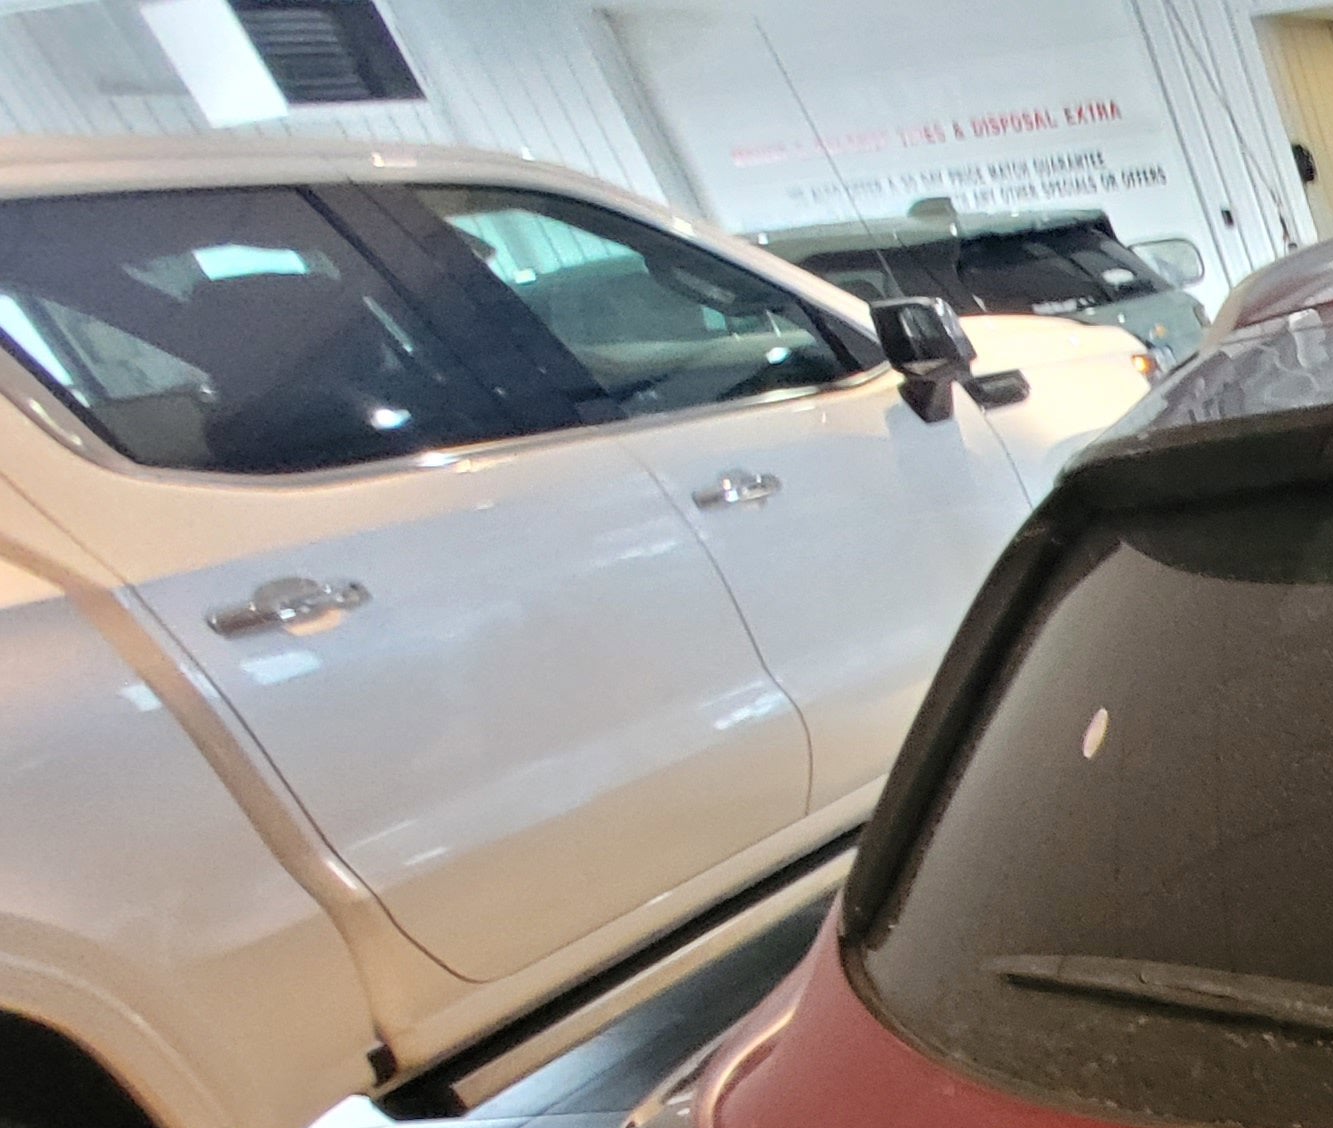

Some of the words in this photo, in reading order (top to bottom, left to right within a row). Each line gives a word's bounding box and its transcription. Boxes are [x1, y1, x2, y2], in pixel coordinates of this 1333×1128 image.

[970, 107, 1058, 139] DISPOSAL
[1063, 98, 1123, 127] EXTRA
[1039, 172, 1098, 199] SPECIALS
[1120, 162, 1167, 190] OFFERS
